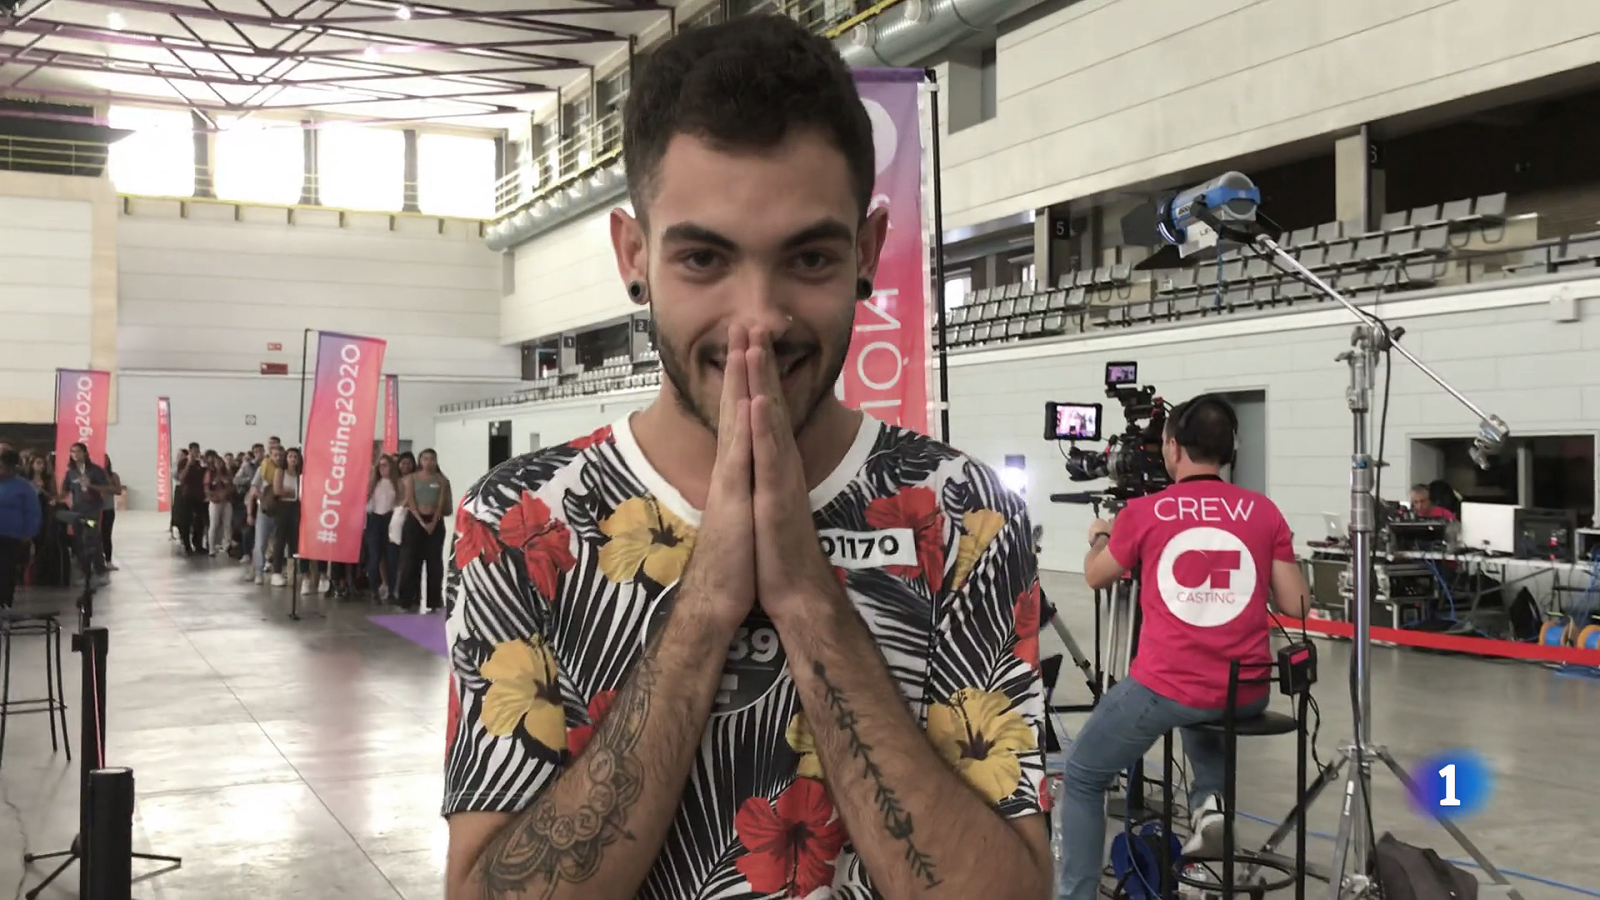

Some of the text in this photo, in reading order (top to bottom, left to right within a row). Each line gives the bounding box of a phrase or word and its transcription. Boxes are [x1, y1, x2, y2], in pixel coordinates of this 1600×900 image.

[1056, 221, 1065, 236] 5
[1154, 496, 1255, 521] CREW
[818, 534, 900, 560] 01170
[1176, 591, 1236, 604] CASTING
